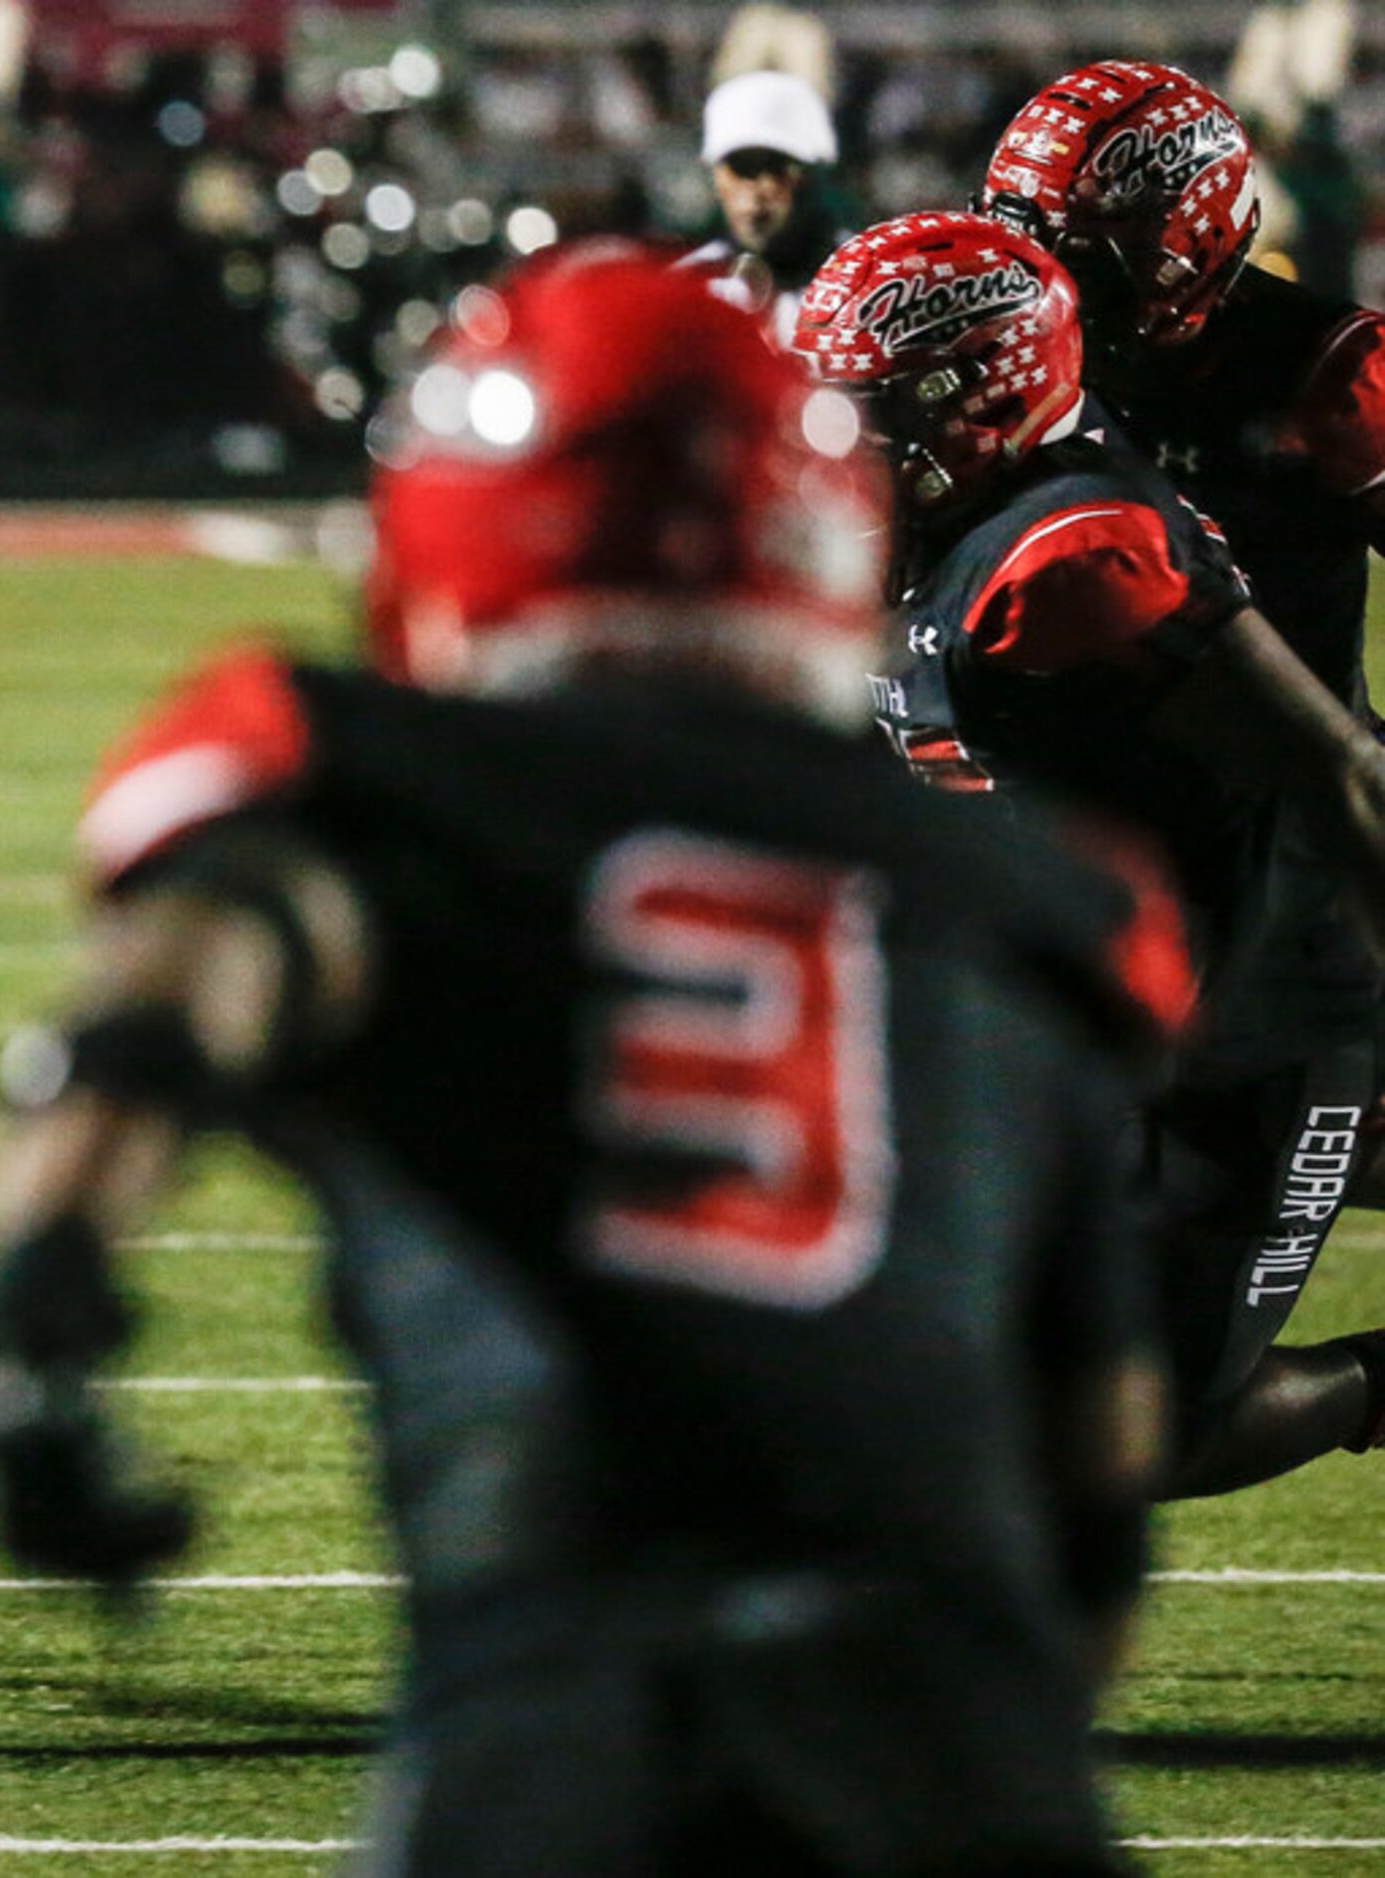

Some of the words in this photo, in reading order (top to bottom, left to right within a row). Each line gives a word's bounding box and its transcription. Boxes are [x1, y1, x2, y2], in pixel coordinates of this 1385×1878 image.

[1093, 105, 1247, 196] Horns
[858, 261, 1043, 358] Horns
[579, 830, 894, 1310] 3
[1279, 1106, 1361, 1221] CEDAR
[1247, 1233, 1318, 1307] HILL
